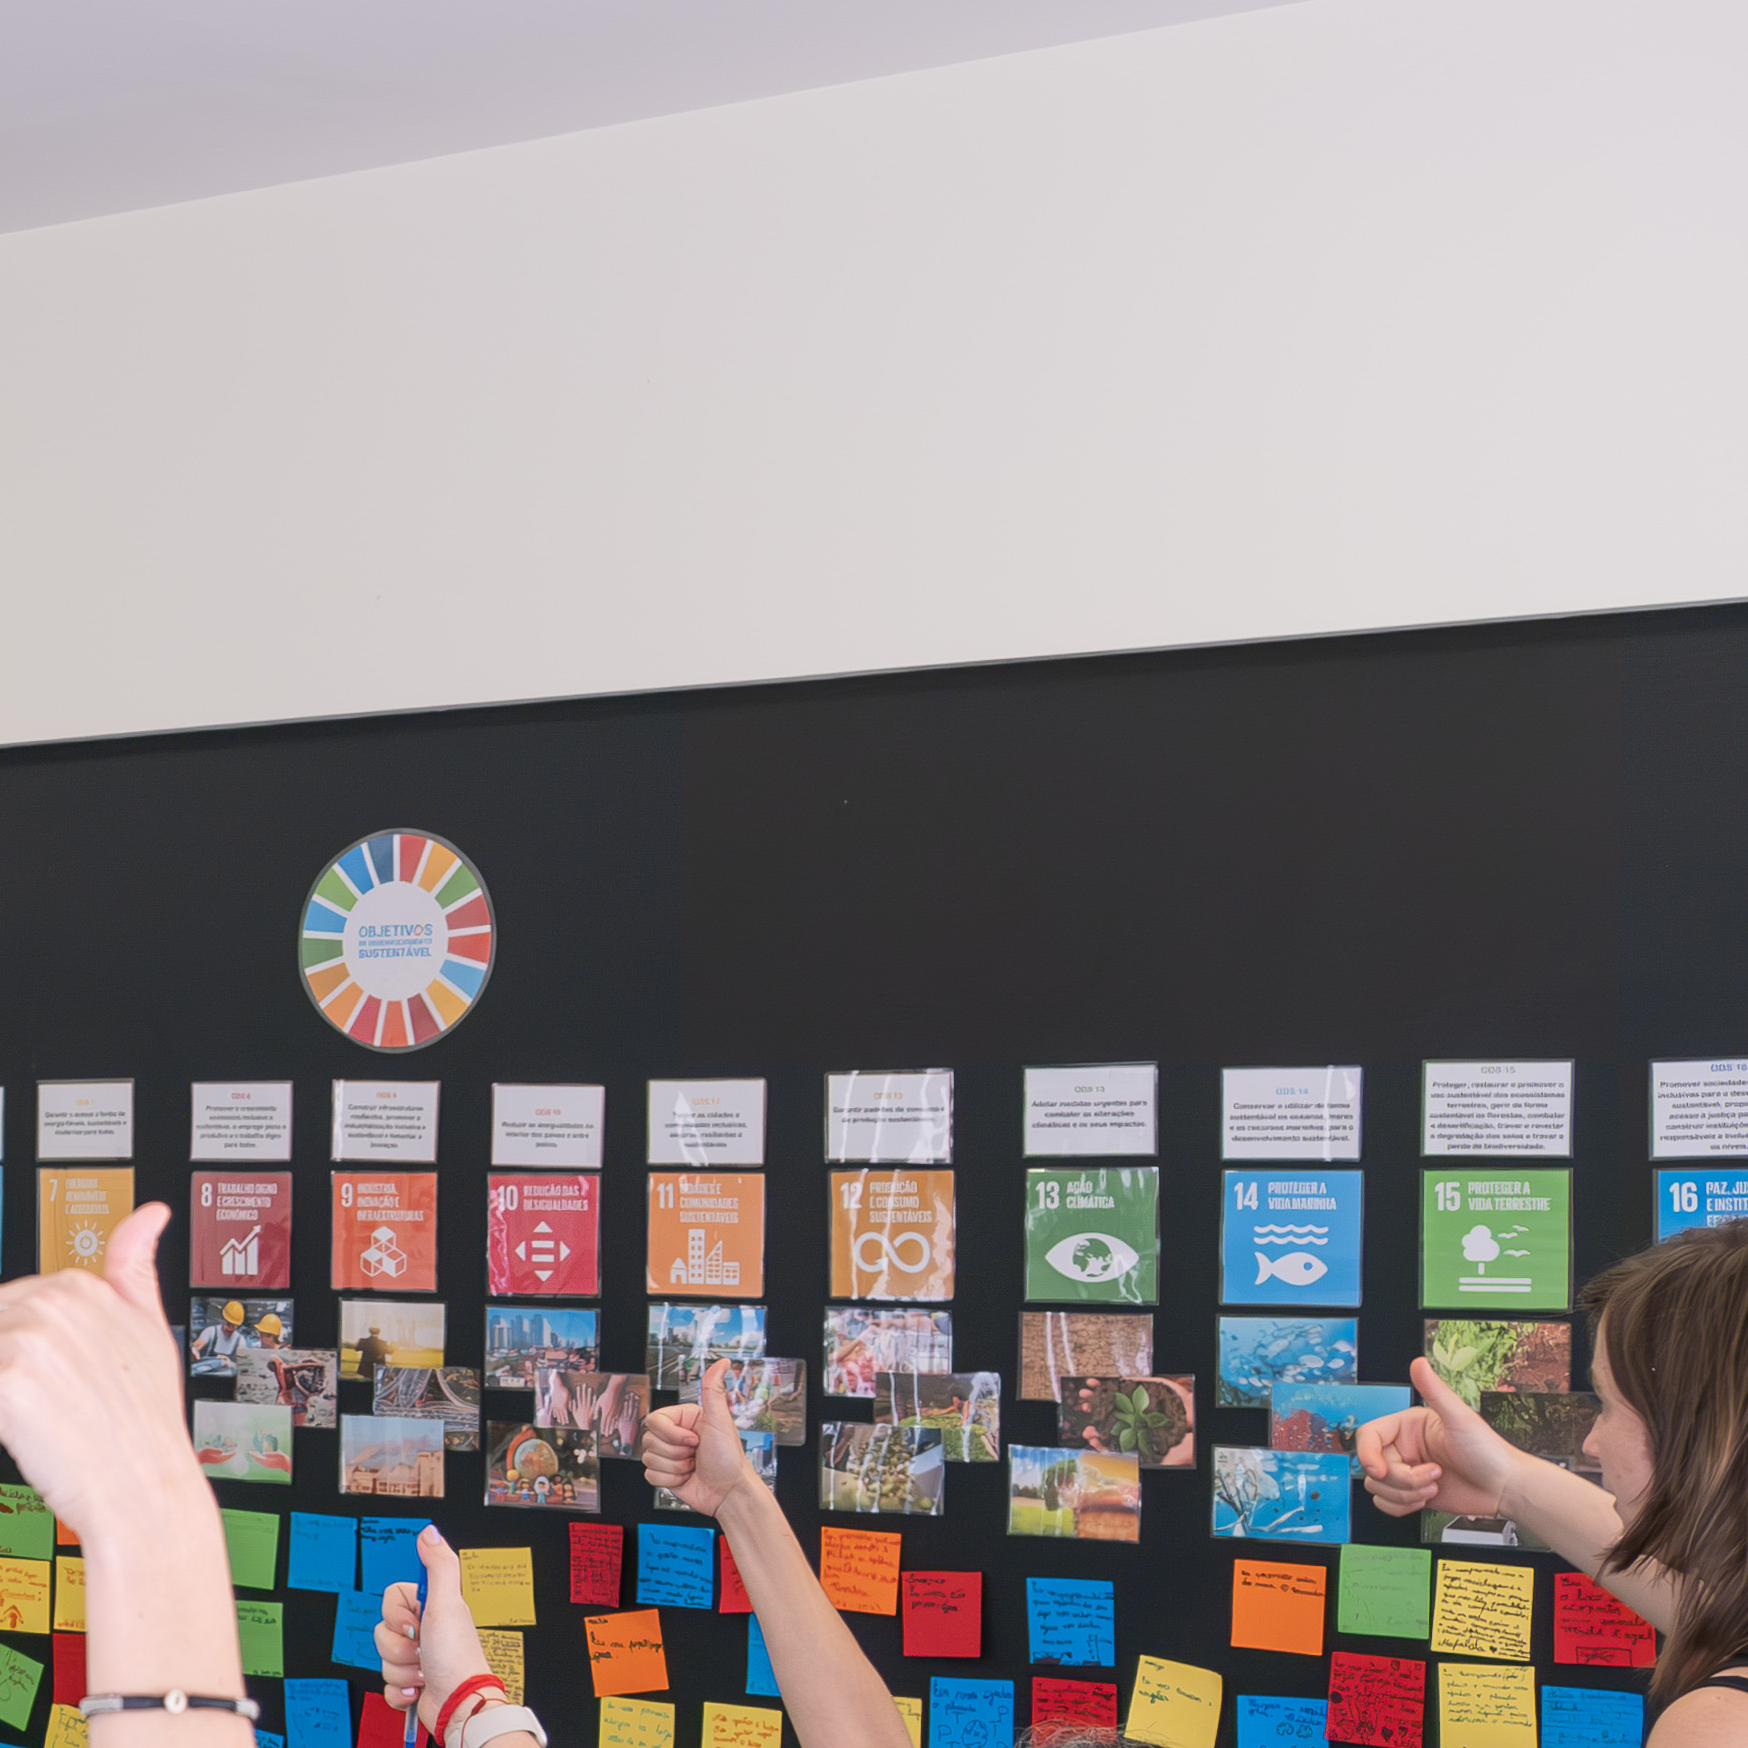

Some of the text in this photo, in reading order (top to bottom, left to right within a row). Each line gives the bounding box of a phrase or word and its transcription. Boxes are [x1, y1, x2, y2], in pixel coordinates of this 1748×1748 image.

[358, 923, 433, 938] OBJETIVOS
[358, 946, 432, 959] SUSTENTÁVEL
[49, 1178, 59, 1202] 7
[200, 1182, 213, 1207] 8
[340, 1182, 353, 1208] 9
[497, 1185, 519, 1211] 10
[657, 1183, 674, 1209] 11
[840, 1182, 862, 1209] 12
[1035, 1181, 1060, 1209] 13
[1233, 1181, 1259, 1211] 14
[1434, 1181, 1461, 1211] 15
[1467, 1181, 1531, 1195] PROTEGER A
[1669, 1181, 1699, 1213] 16
